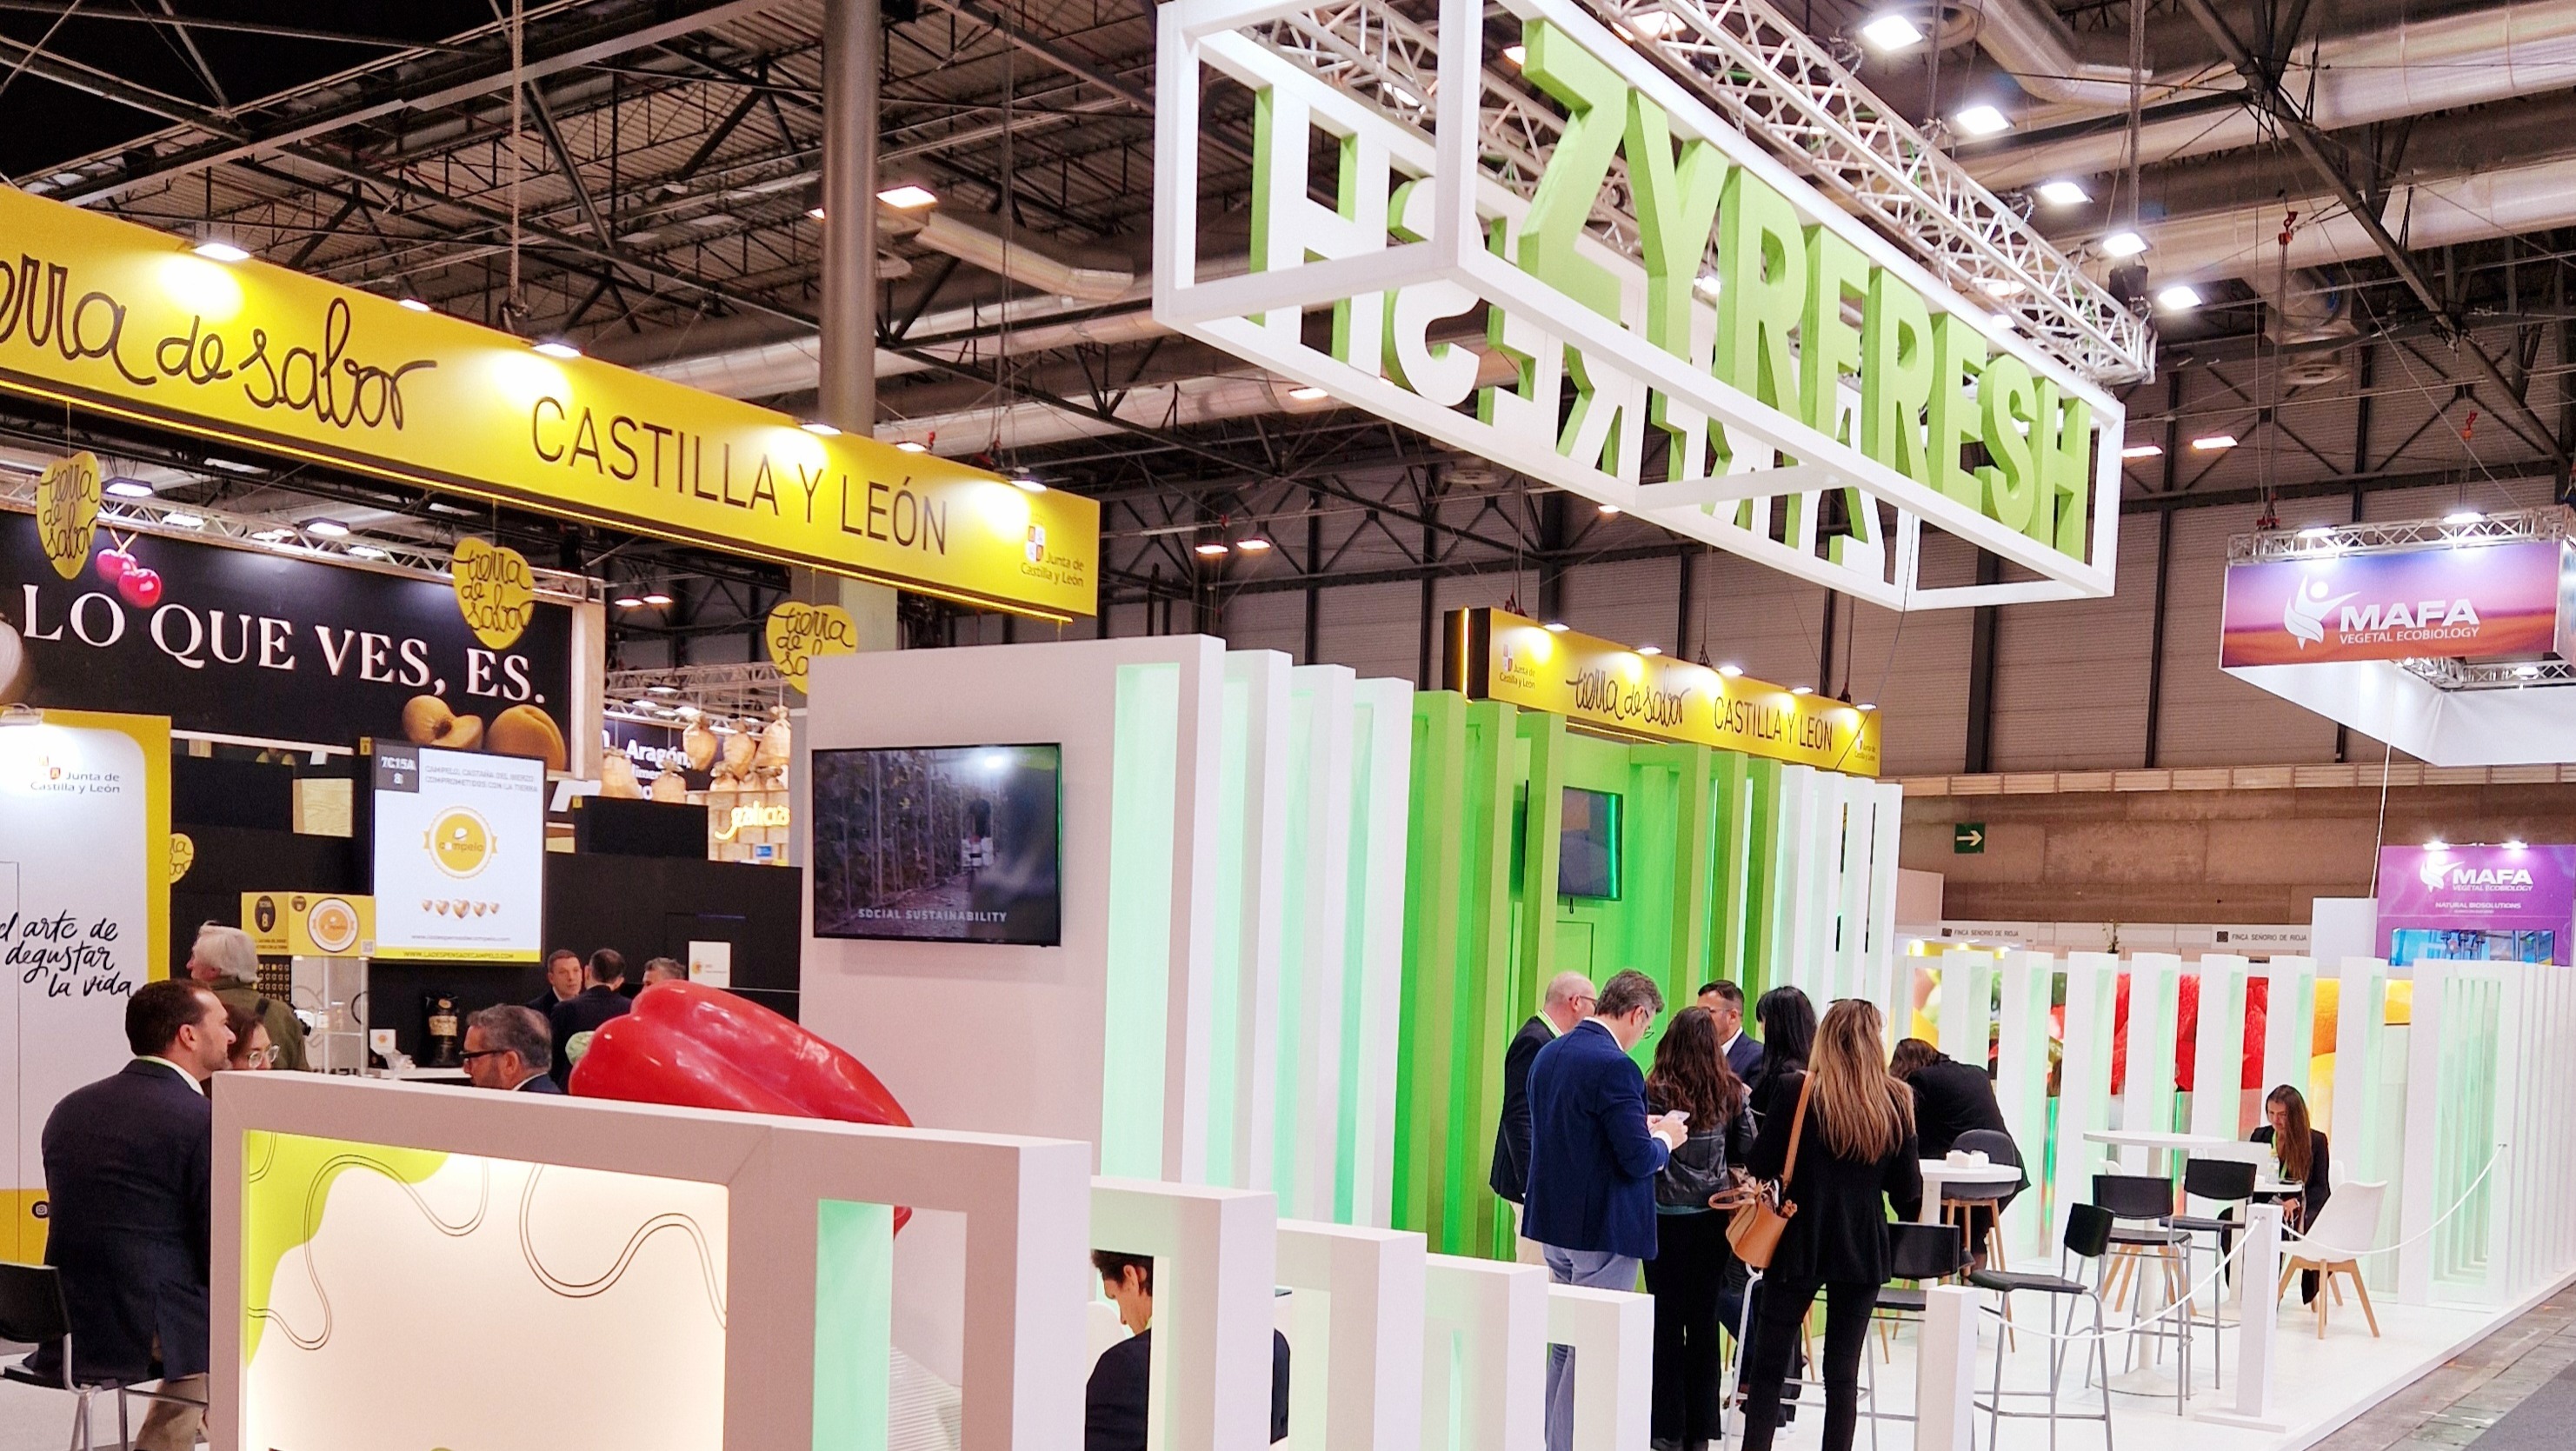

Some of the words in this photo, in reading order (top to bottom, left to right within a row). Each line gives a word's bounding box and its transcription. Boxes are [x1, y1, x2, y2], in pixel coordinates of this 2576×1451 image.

[1521, 17, 2092, 563] ZYRFRESH
[156, 315, 233, 385] de
[239, 297, 437, 430] sabor
[532, 396, 779, 517] CASTILLA
[798, 463, 824, 524] Y
[840, 474, 947, 556] LEÓN
[40, 464, 98, 503] tierra
[43, 501, 62, 526] de
[47, 502, 97, 560] sabor
[453, 549, 531, 589] tierra
[1021, 562, 1052, 580] Castilla
[1054, 572, 1061, 586] y
[1046, 552, 1070, 569] Junta
[1073, 557, 1085, 572] de
[462, 579, 484, 601] de
[468, 583, 535, 632] sabor
[2339, 598, 2480, 633] MAFA
[770, 607, 855, 648] tierra
[775, 633, 803, 651] de
[2339, 630, 2393, 646] VEGETAL
[2396, 626, 2480, 642] ECOBIOLOGY
[22, 583, 126, 648] LO
[150, 603, 296, 670] QUE
[315, 623, 447, 696] VES,
[465, 647, 546, 703] ES.
[1565, 666, 1625, 721] tierra
[1624, 683, 1642, 716] de
[1642, 662, 1691, 728] sabor
[1714, 696, 1782, 742] CASTILLA
[1787, 712, 1796, 744] Y
[1799, 710, 1834, 753] LEÓN
[30, 781, 75, 792] Castilla
[78, 784, 85, 795] y
[90, 783, 121, 793] León
[66, 771, 101, 781] Junta
[104, 772, 120, 781] de
[394, 773, 404, 785] 8
[2453, 869, 2534, 885] MAFA
[23, 909, 77, 943] arte
[90, 917, 118, 942] de
[858, 908, 901, 919] SOCIAL
[905, 909, 1008, 922] SUSTAINABILITY
[5, 940, 115, 983] degustar
[49, 973, 71, 997] la
[83, 971, 132, 997] vida
